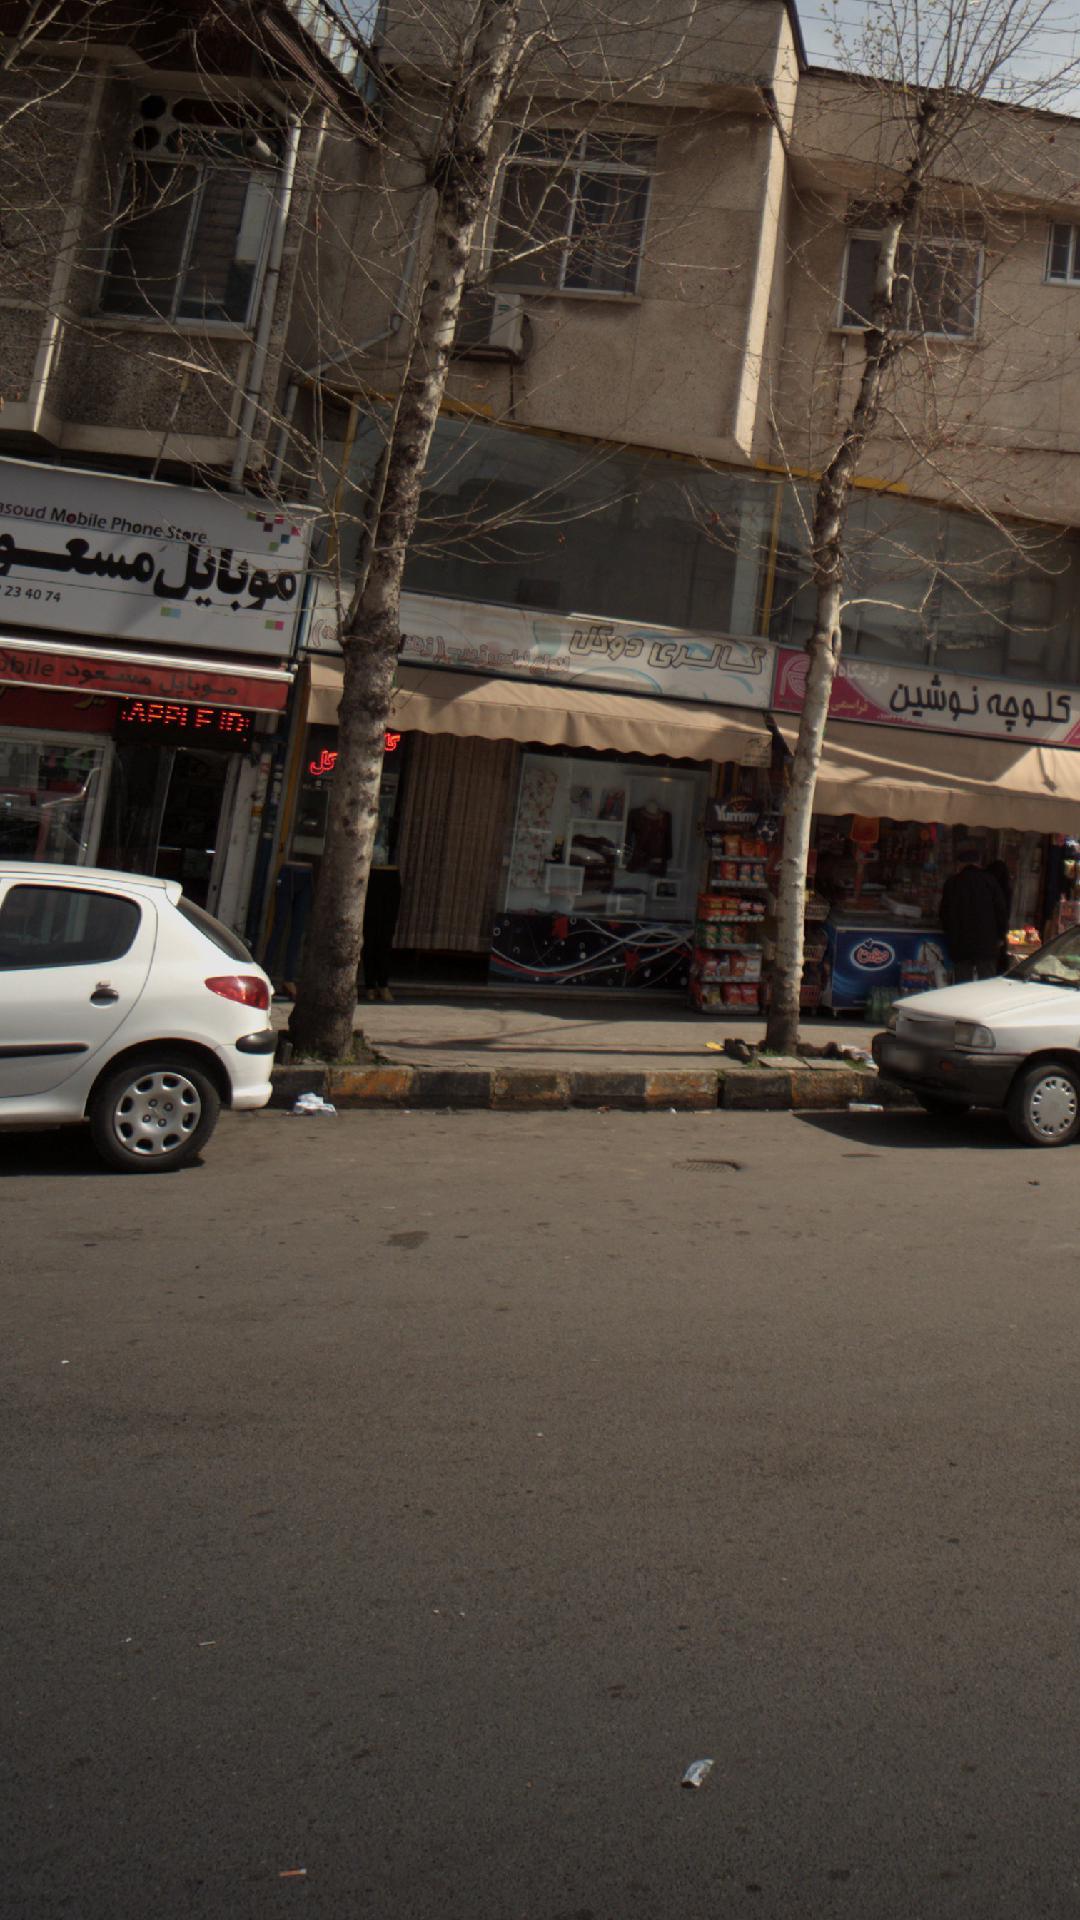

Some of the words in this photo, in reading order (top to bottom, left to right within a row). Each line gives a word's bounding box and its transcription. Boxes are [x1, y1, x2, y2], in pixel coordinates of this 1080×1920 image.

[51, 507, 107, 529] Mobile
[110, 516, 163, 537] Phone
[166, 526, 208, 545] Store
[4, 585, 22, 597] 23
[25, 588, 42, 600] 40
[45, 590, 61, 602] 74
[153, 544, 297, 610] موبایل
[64, 664, 152, 686] مسعود
[647, 641, 767, 675] گالری
[889, 674, 979, 721] نوشین
[987, 690, 1072, 731] کلوچه
